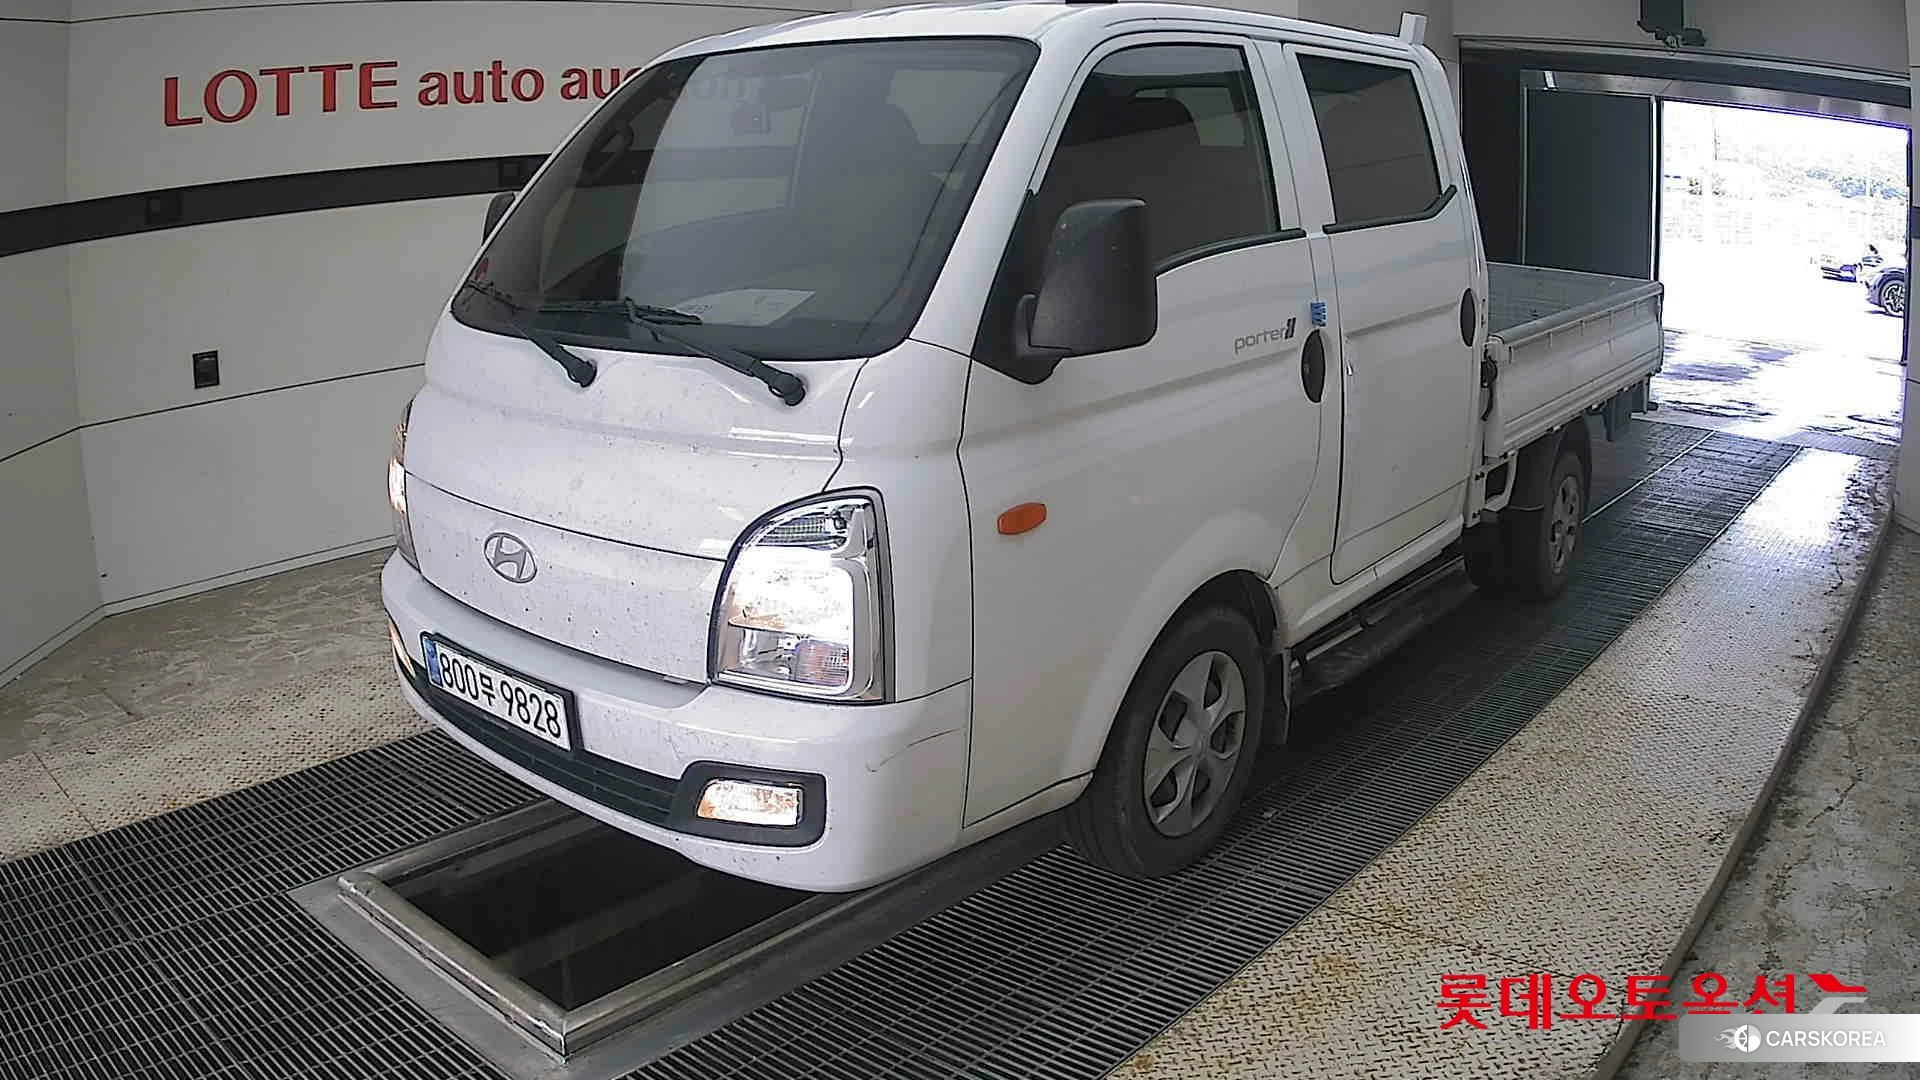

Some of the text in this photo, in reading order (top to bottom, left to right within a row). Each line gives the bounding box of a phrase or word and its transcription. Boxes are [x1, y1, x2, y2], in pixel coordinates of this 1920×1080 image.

[164, 60, 399, 127] LOTTE
[417, 60, 545, 106] auto
[1234, 326, 1287, 356] porter
[439, 652, 562, 739] 800무 9828
